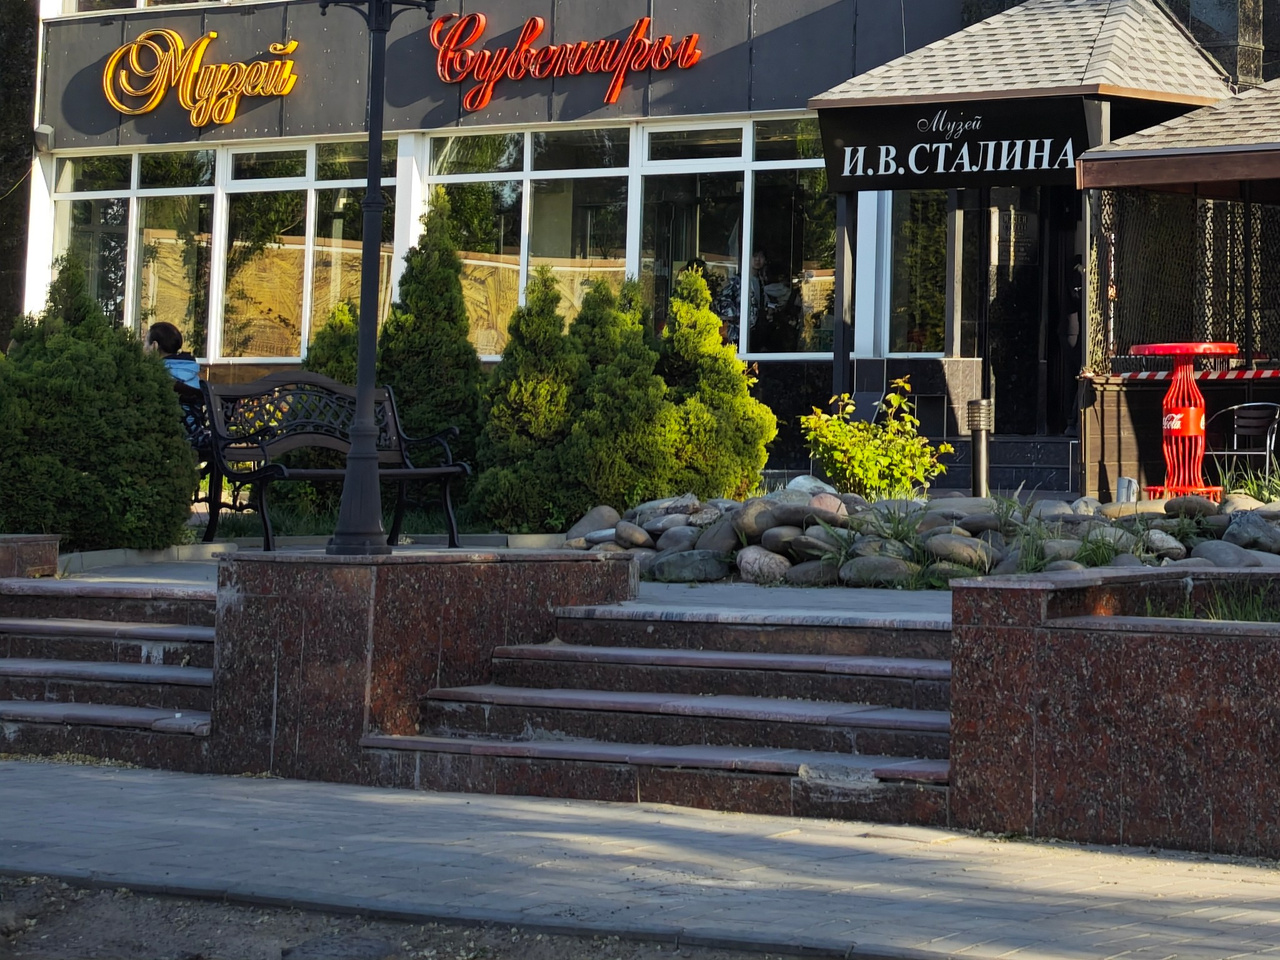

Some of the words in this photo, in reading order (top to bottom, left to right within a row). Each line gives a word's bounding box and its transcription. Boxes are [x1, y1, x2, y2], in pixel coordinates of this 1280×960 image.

[102, 28, 299, 127] Музей
[429, 12, 702, 113] Сувениры
[841, 137, 1077, 177] И.В.СТАЛИНА
[916, 109, 983, 140] Музей
